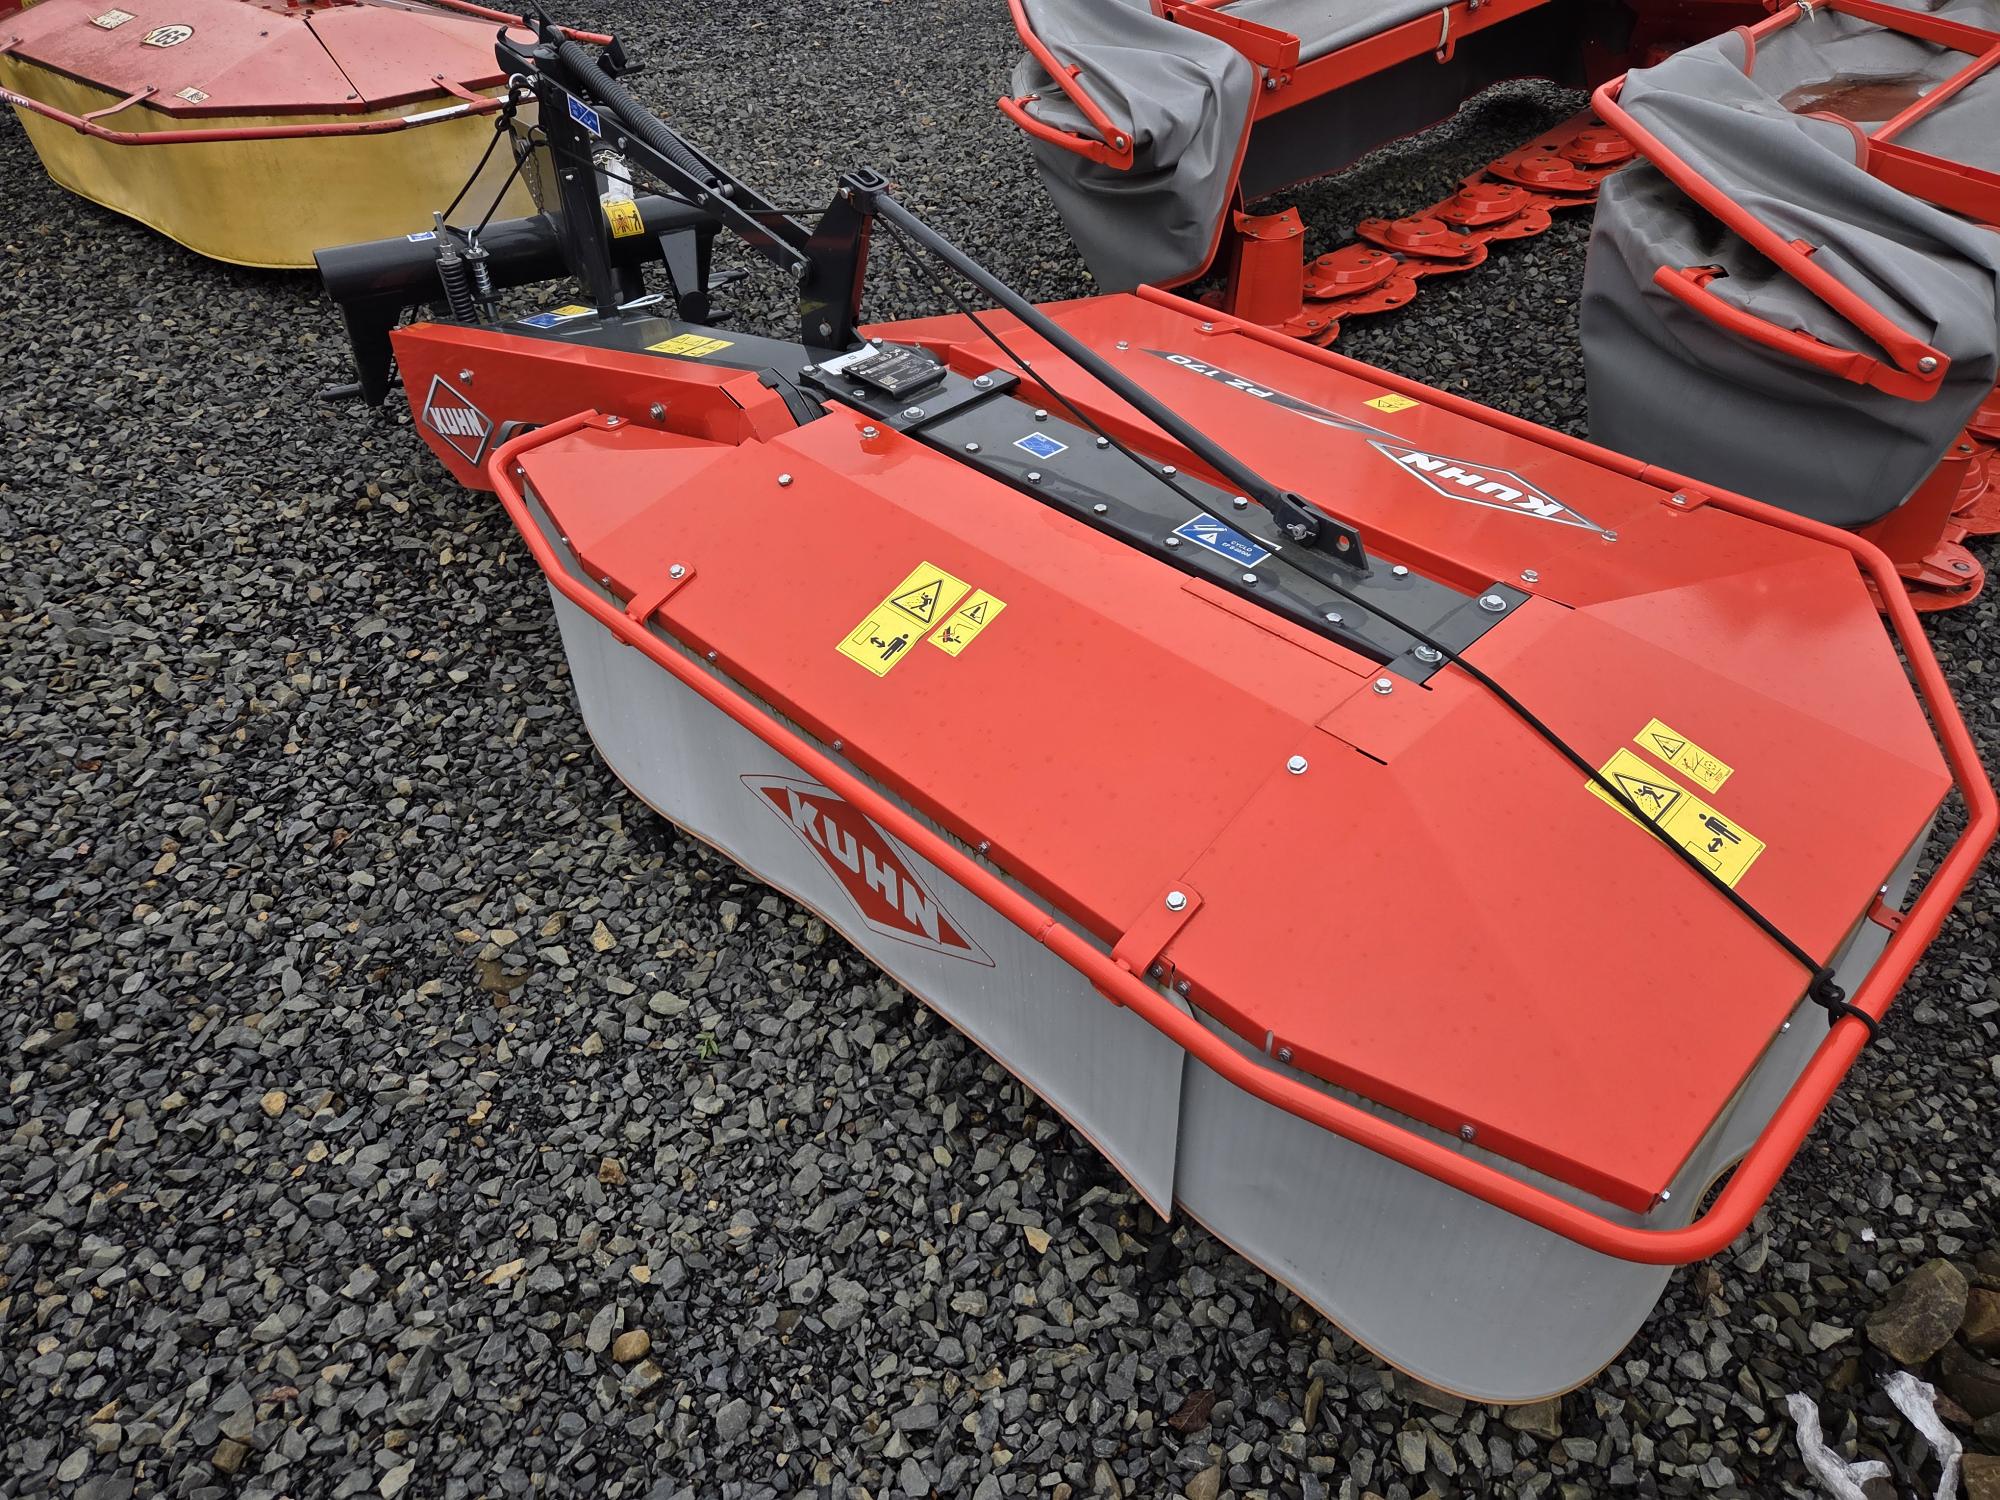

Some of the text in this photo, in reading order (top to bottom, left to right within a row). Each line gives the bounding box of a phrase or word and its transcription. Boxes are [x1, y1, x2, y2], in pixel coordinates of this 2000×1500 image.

[151, 28, 187, 45] 165
[1166, 354, 1274, 398] PZ 170
[429, 407, 486, 437] KUHN
[1398, 452, 1565, 517] KUHN
[1230, 540, 1253, 552] CYCLO
[785, 786, 942, 945] KUHN
